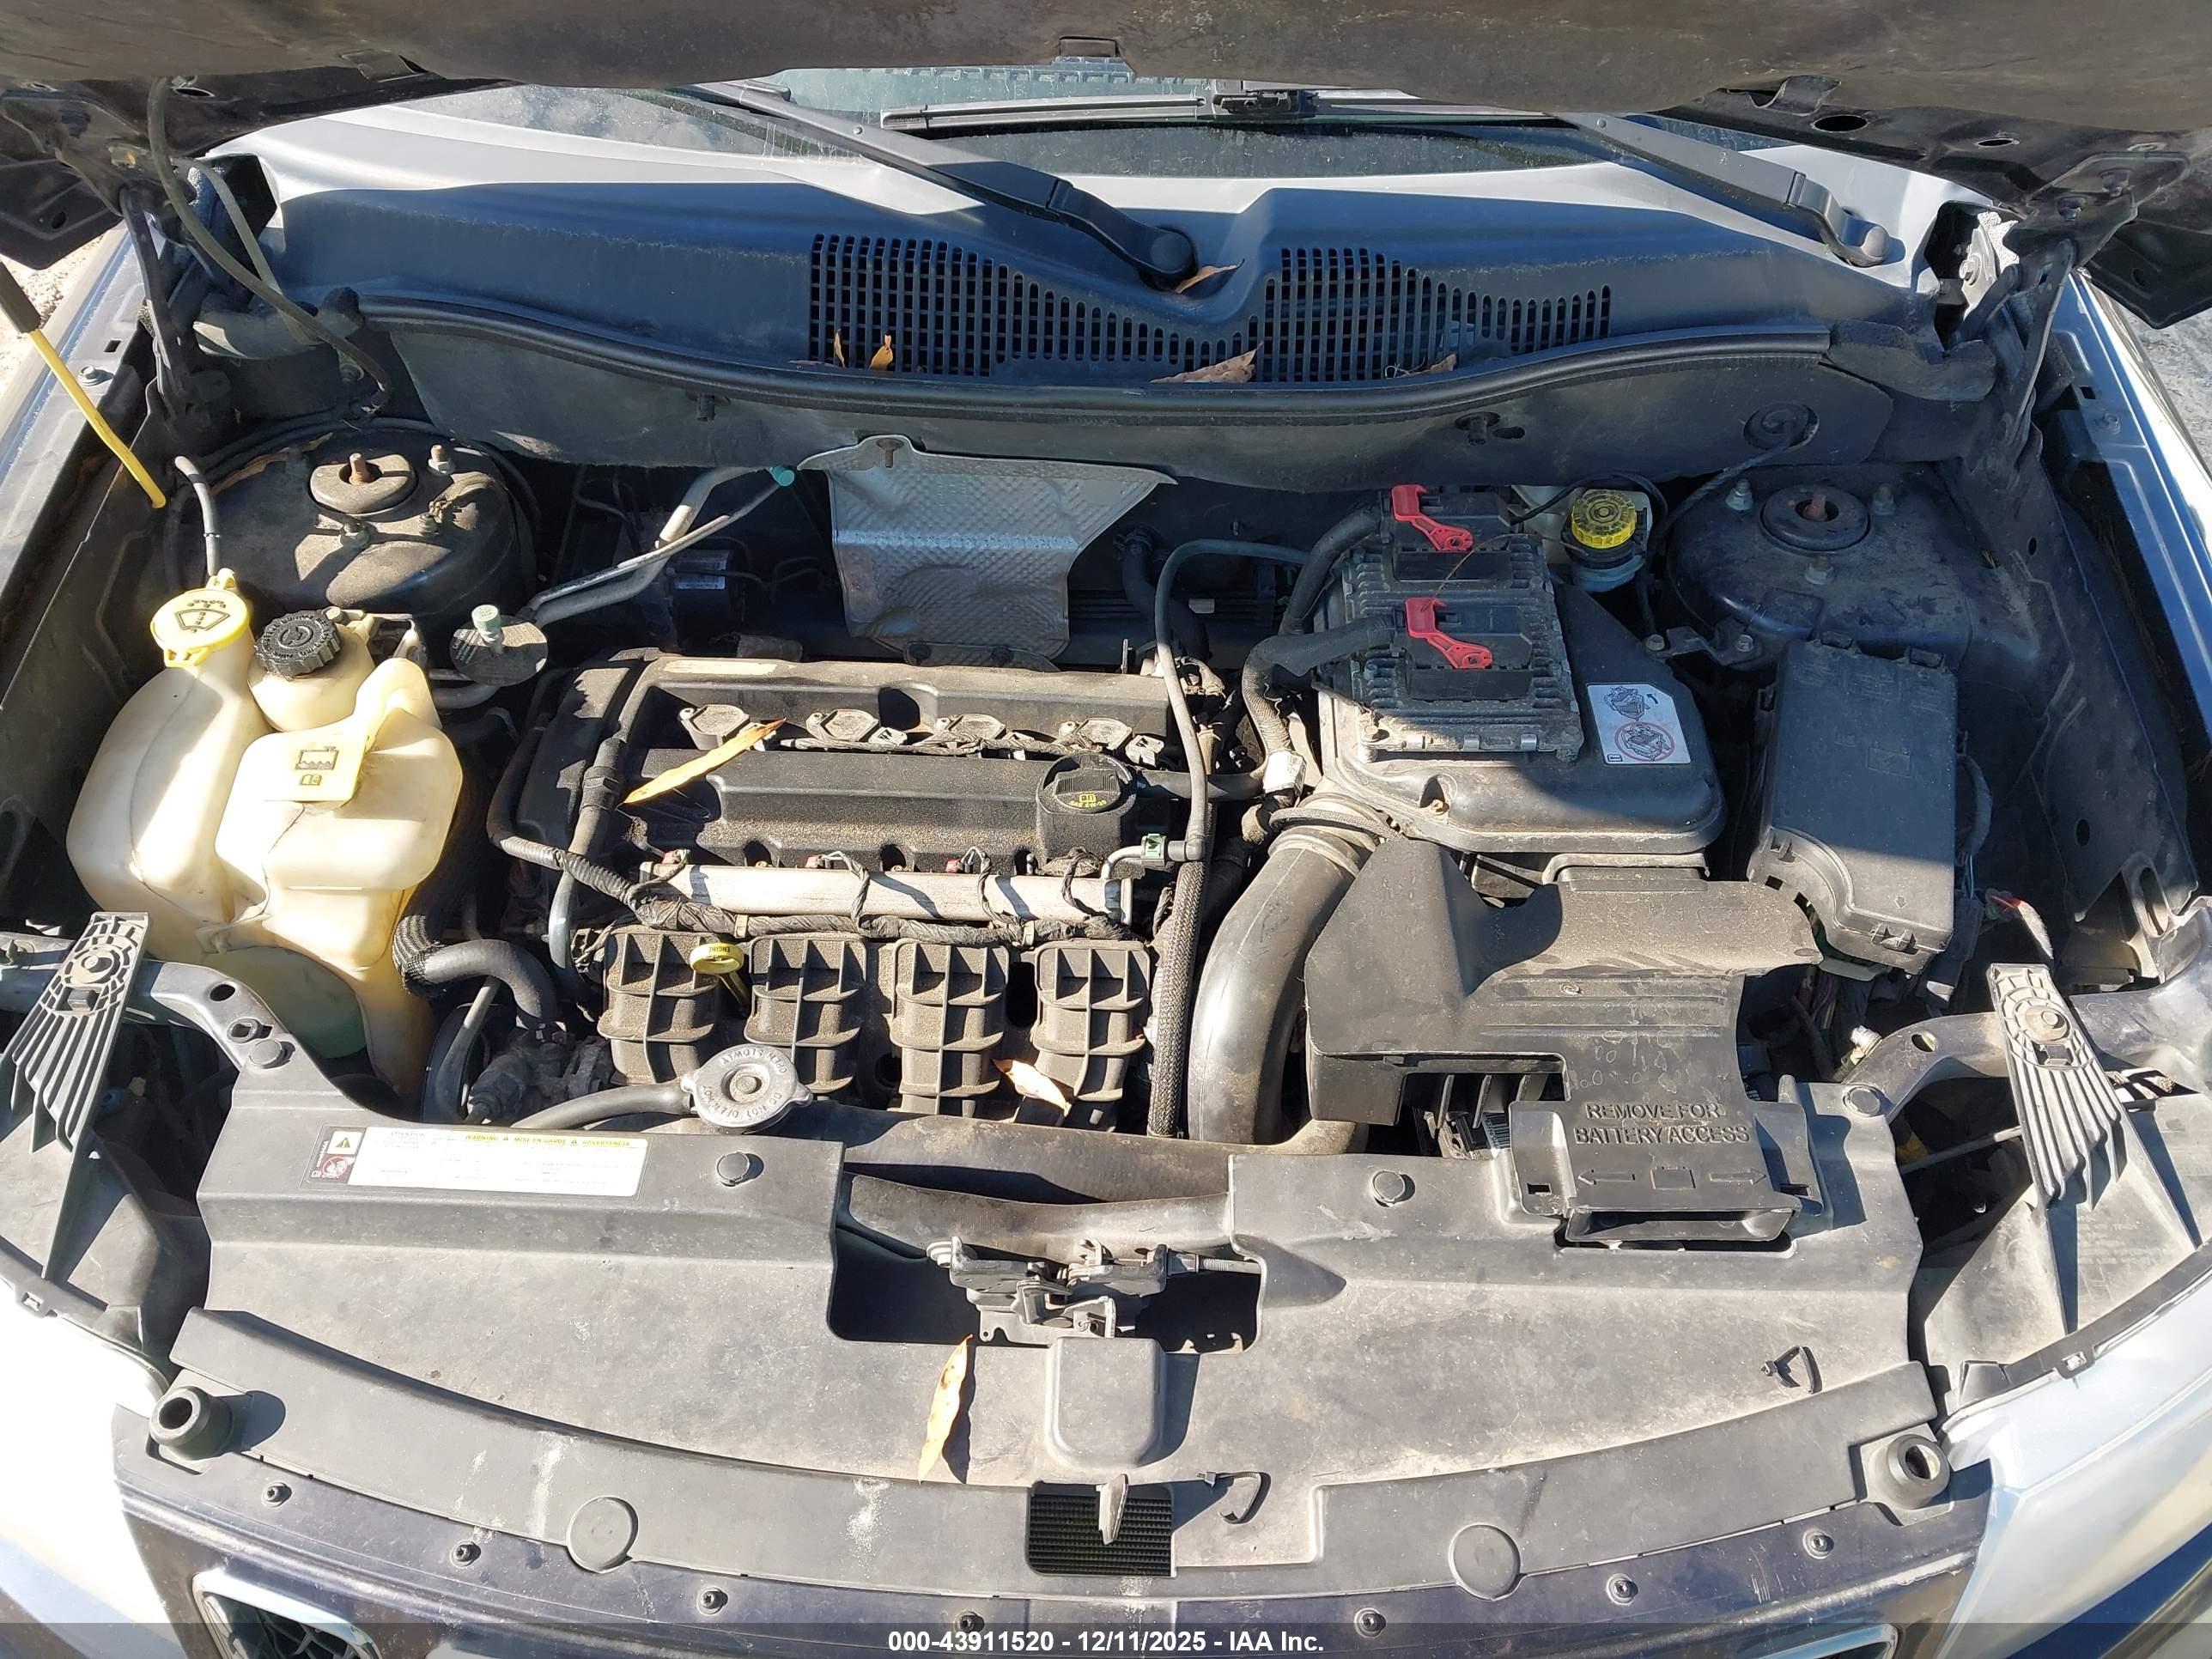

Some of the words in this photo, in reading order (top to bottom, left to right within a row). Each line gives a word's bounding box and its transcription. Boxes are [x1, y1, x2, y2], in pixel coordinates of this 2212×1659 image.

[766, 1050, 787, 1073] OPEN
[1586, 1103, 1675, 1120] REMOVE
[1677, 1103, 1720, 1119] FOR
[465, 1133, 498, 1142] WARNING
[1575, 1126, 1664, 1145] BATTERY
[1668, 1125, 1750, 1144] ACCESS
